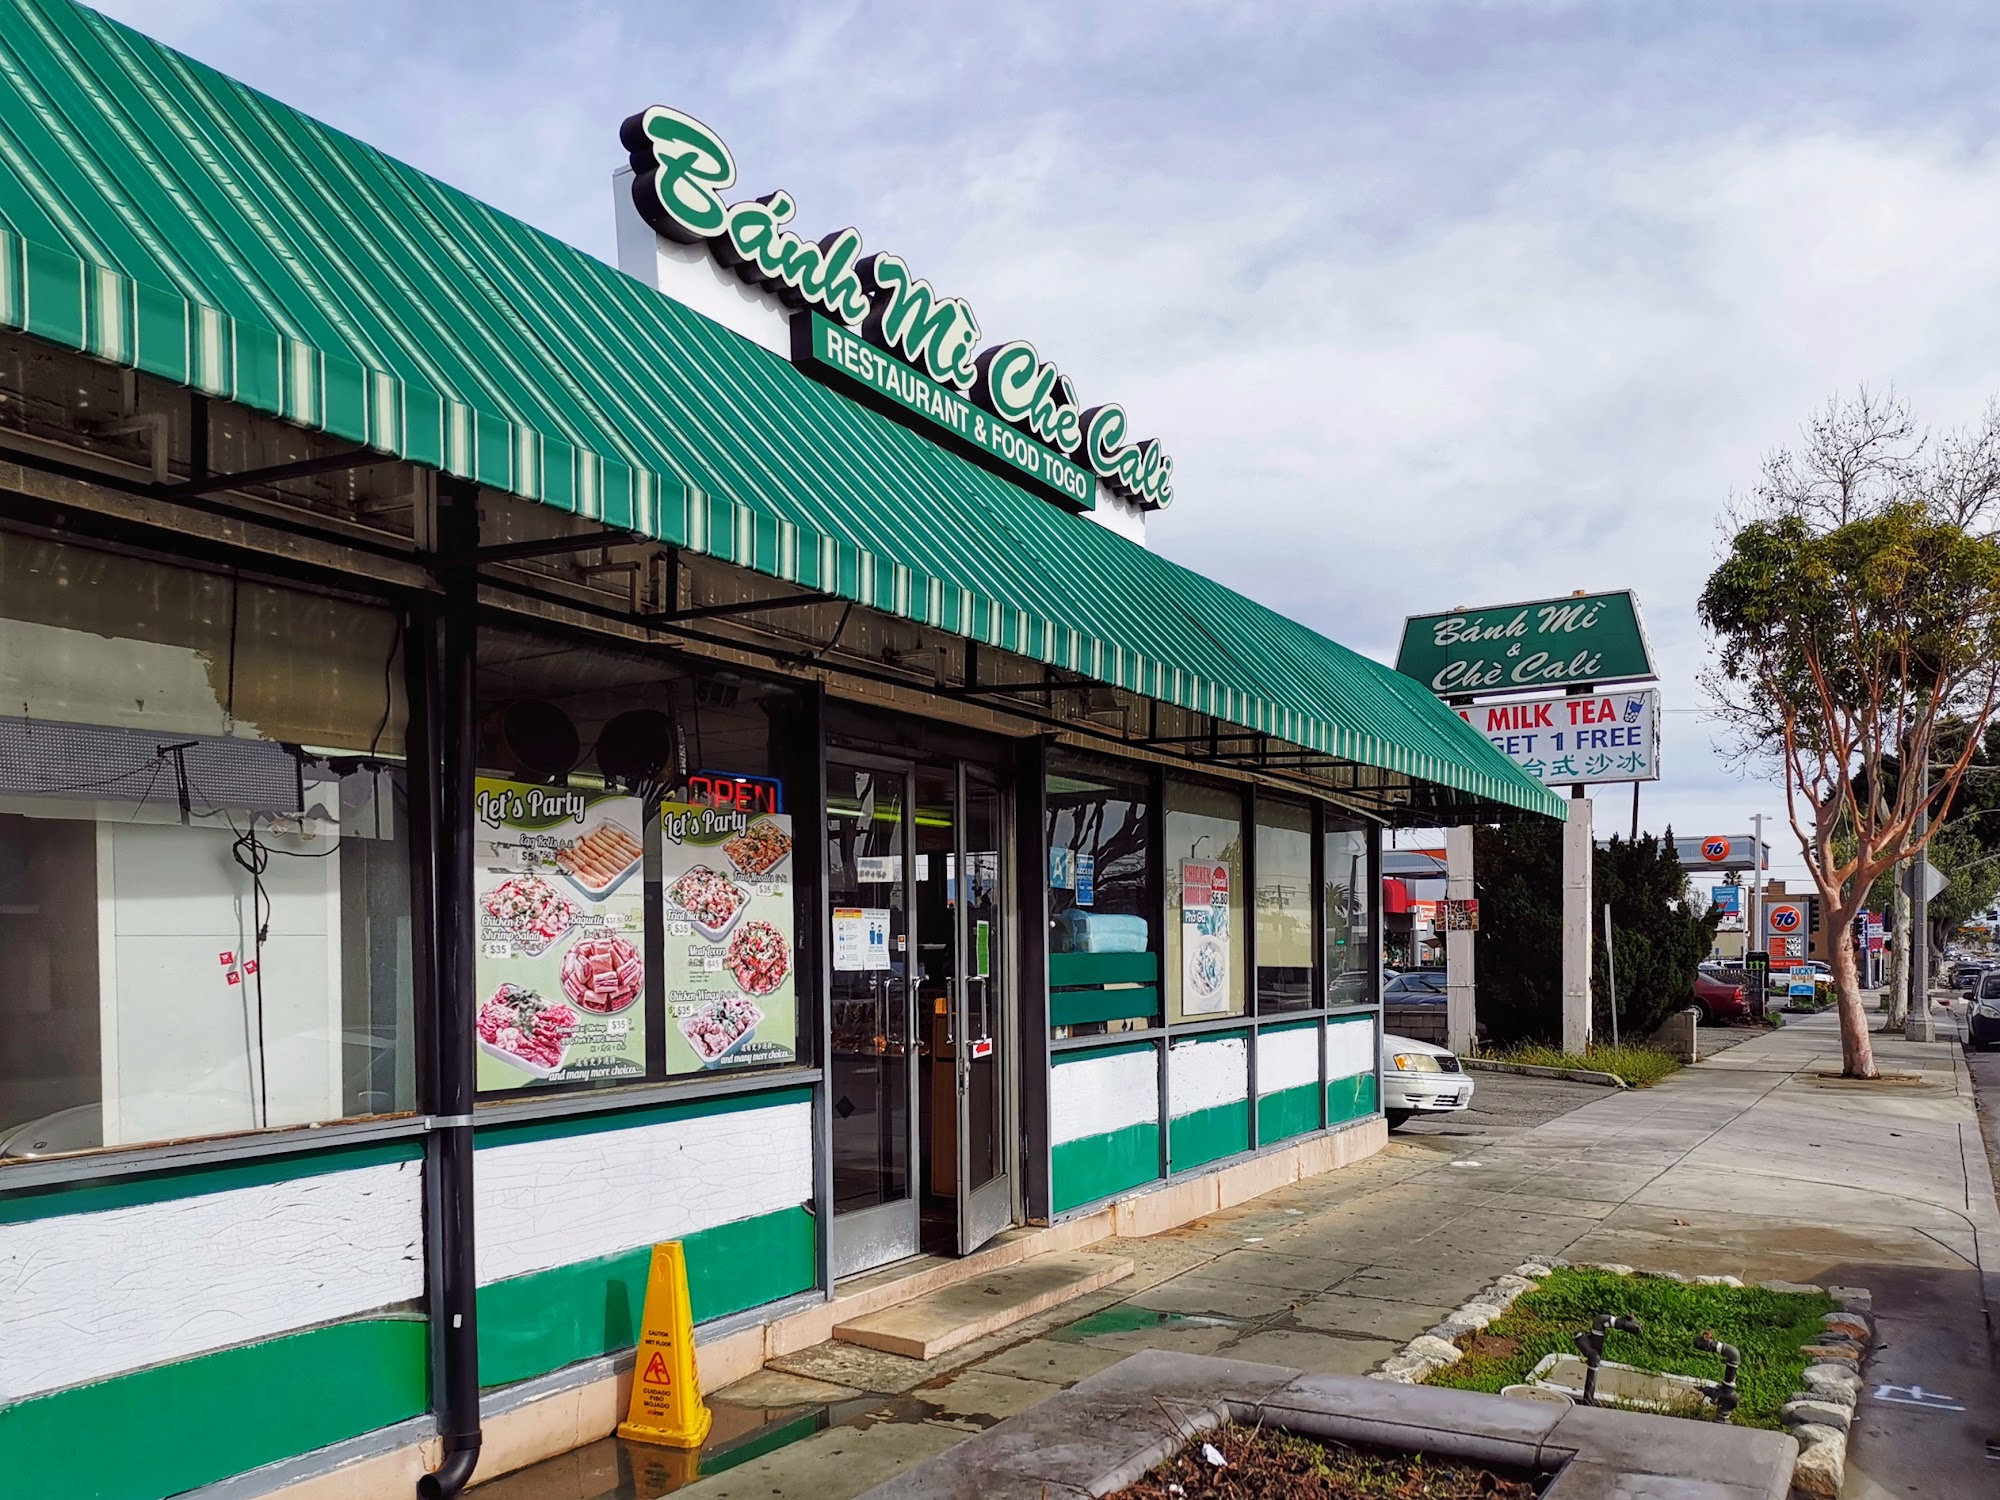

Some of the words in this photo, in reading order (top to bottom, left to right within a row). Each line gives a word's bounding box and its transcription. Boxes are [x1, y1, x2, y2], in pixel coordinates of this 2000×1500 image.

[643, 106, 869, 325] Bánh
[875, 253, 981, 390] Mì
[989, 341, 1081, 453] Chè
[1088, 403, 1173, 509] Cali
[827, 327, 969, 433] RESTAURANT
[974, 415, 988, 445] &
[992, 424, 1040, 472] FOOD
[1043, 453, 1087, 499] TOGO
[1433, 609, 1529, 646] Bánh
[1506, 642, 1521, 658] &
[1432, 660, 1503, 690] Chè
[1511, 650, 1602, 683] Cali
[1487, 703, 1554, 731] MILK
[1566, 698, 1616, 726] TEA
[1550, 732, 1564, 751] 1
[1577, 726, 1642, 749] FREE
[689, 776, 775, 815] OPEN
[477, 789, 525, 829] Let's
[527, 788, 586, 824] Party
[664, 809, 700, 845] Let's
[702, 808, 747, 837] Party
[1705, 841, 1724, 856] 76
[1052, 857, 1063, 880] A
[481, 914, 514, 927] Chicken
[667, 909, 685, 921] Fried
[1774, 911, 1797, 927] 76
[481, 929, 514, 943] Shrimp
[515, 929, 540, 942] Salad
[675, 925, 688, 933] $35
[490, 945, 506, 954] $35
[1791, 967, 1814, 975] LUCKY
[669, 990, 696, 1002] Chicken
[697, 989, 719, 1003] Wings
[677, 1006, 690, 1014] $35
[612, 1020, 625, 1029] $35
[720, 1054, 733, 1064] and
[734, 1054, 752, 1064] many
[752, 1053, 767, 1061] more
[549, 1069, 565, 1081] and
[566, 1069, 590, 1081] many
[590, 1067, 611, 1077] more
[643, 1388, 671, 1396] CUIDADO
[643, 1400, 670, 1409] MOJADO
